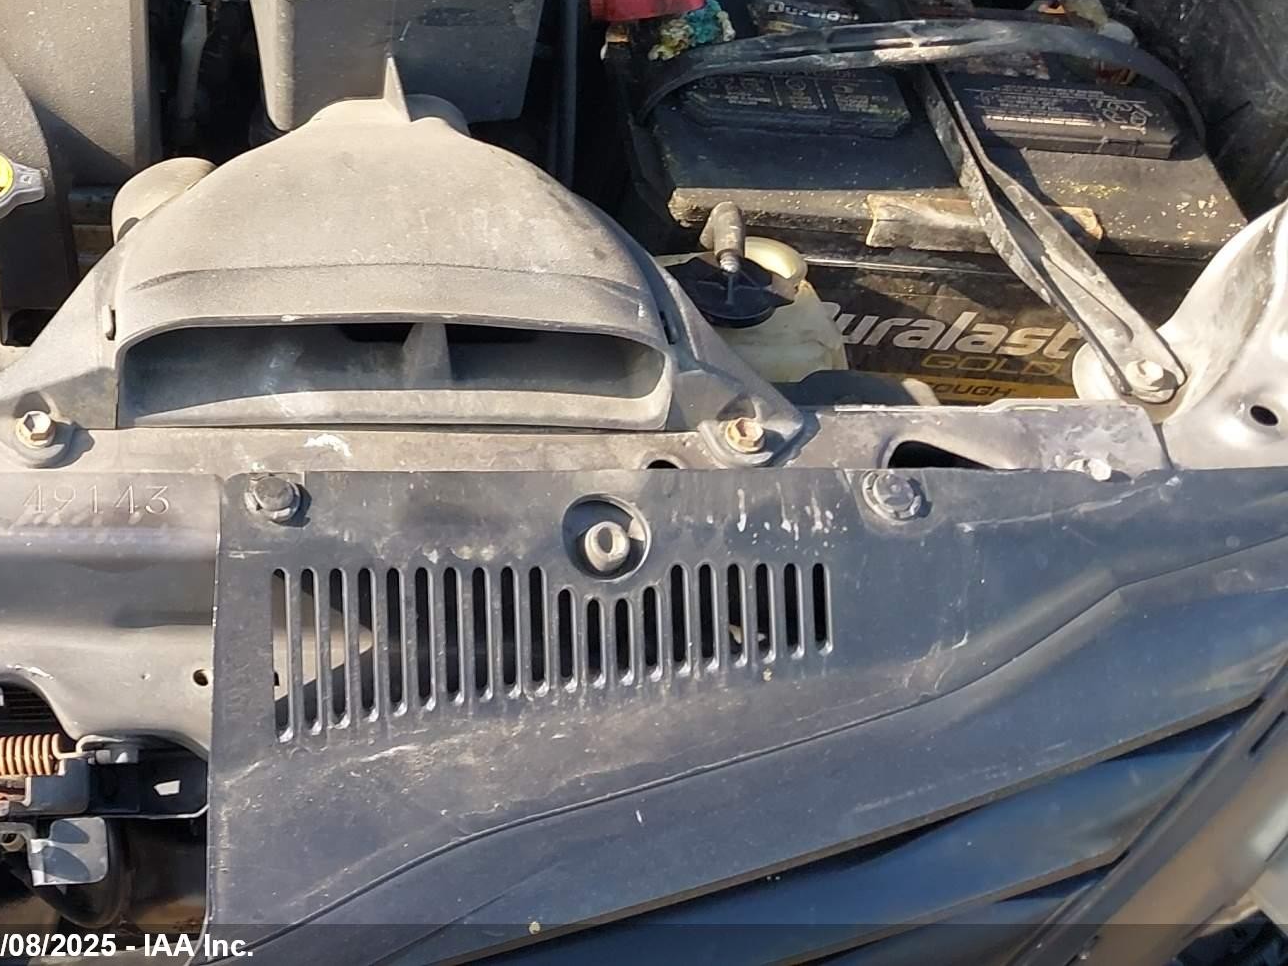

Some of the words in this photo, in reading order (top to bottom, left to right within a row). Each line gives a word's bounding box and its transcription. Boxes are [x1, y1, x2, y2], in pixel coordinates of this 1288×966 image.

[920, 353, 1062, 377] GOLD
[929, 383, 1012, 398] OUGH
[23, 483, 170, 515] 49143
